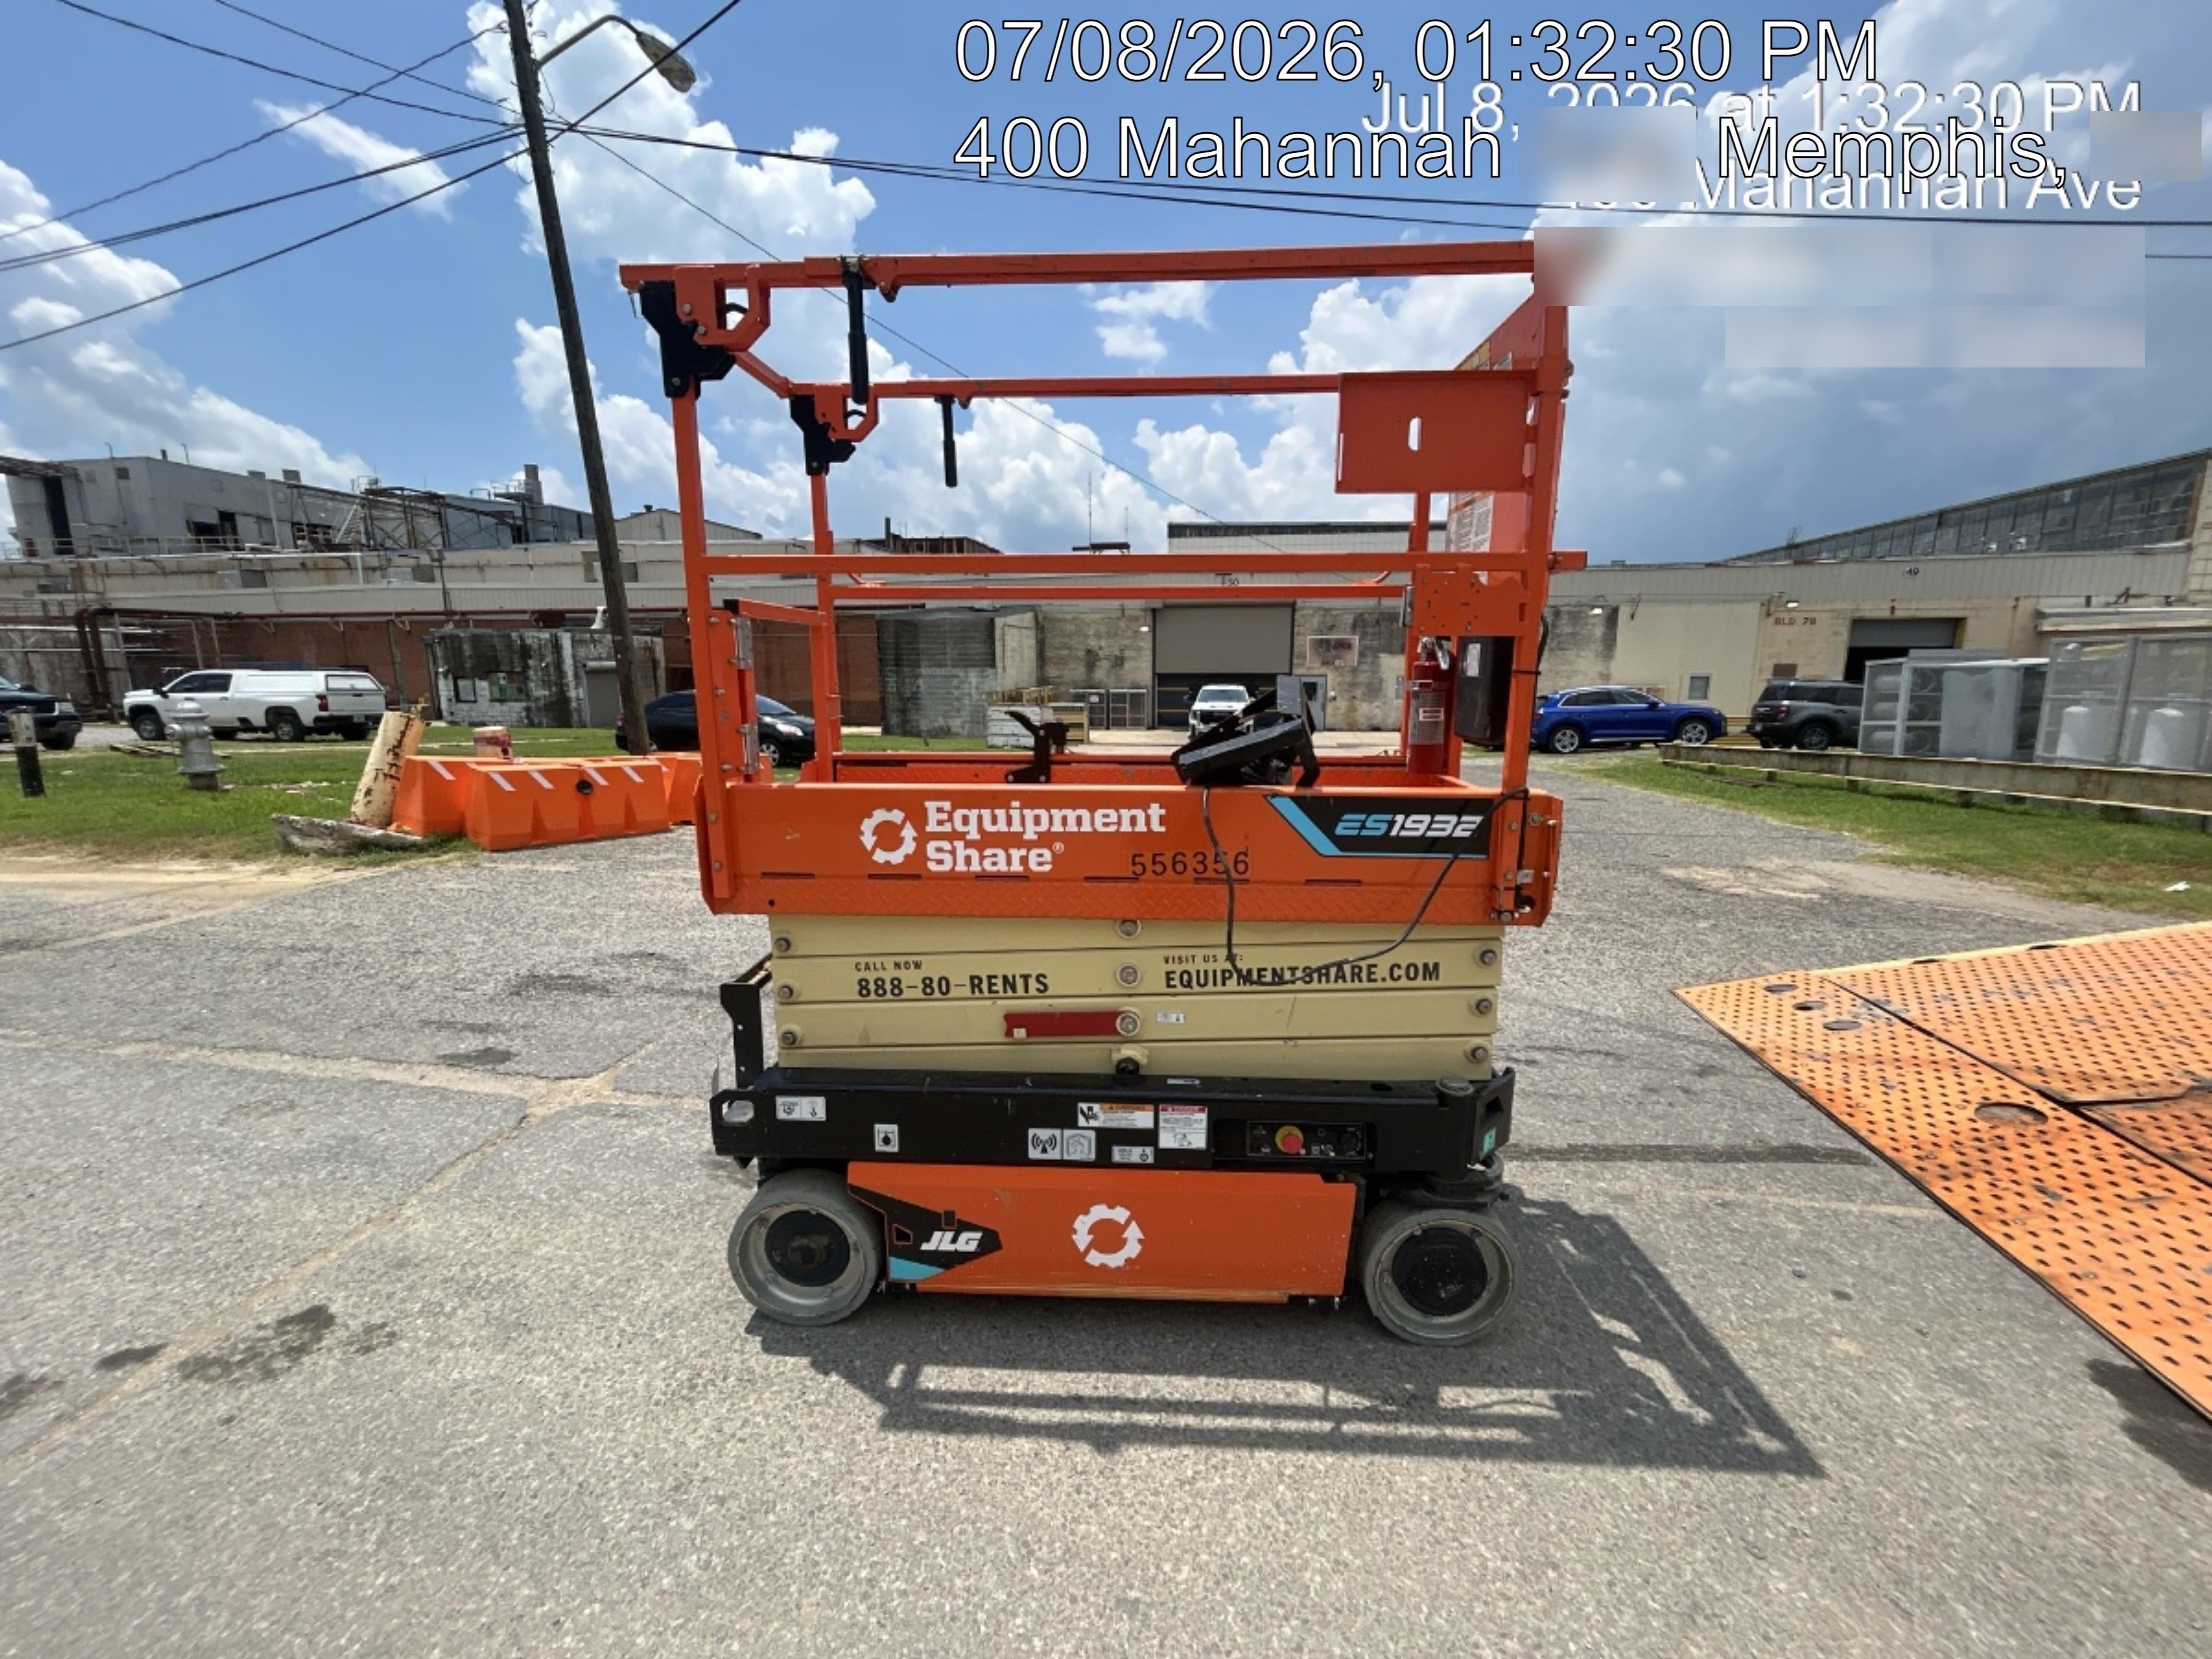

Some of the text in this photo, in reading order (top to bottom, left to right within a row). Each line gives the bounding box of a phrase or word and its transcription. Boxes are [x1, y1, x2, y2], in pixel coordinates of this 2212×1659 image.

[924, 801, 1166, 840] Equipment
[1334, 814, 1484, 838] ES1932
[1131, 850, 1249, 877] 556356
[855, 960, 924, 972] CALL NOW
[1163, 954, 1197, 965] VISIT
[1203, 954, 1218, 963] US
[857, 973, 1049, 998] 888-80-RENTS
[920, 1231, 983, 1252] JLG
